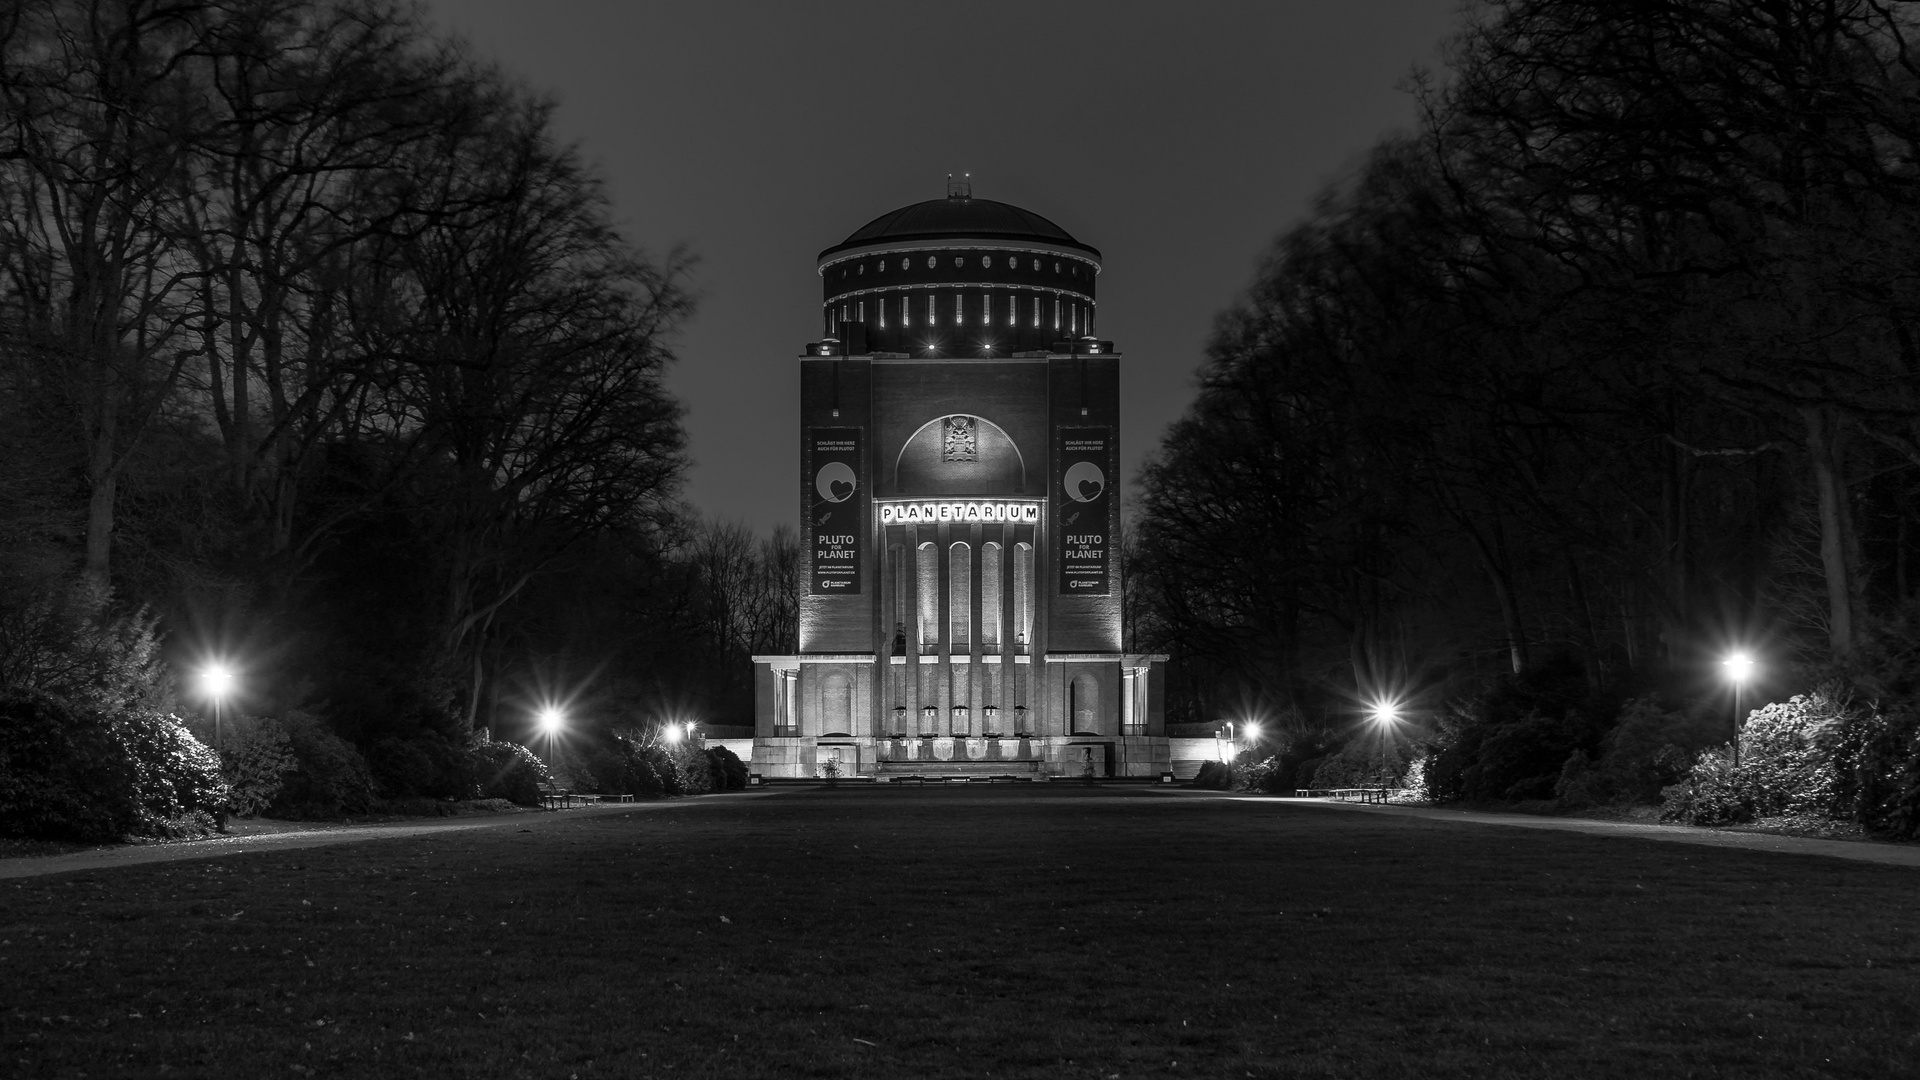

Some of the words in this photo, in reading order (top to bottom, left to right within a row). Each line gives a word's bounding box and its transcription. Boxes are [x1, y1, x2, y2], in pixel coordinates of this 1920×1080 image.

[883, 505, 1037, 520] PLANETARIUM
[818, 535, 854, 544] PLUTO
[1066, 535, 1102, 544] PLUTO
[818, 550, 856, 558] PLANET
[1066, 550, 1103, 558] PLANET
